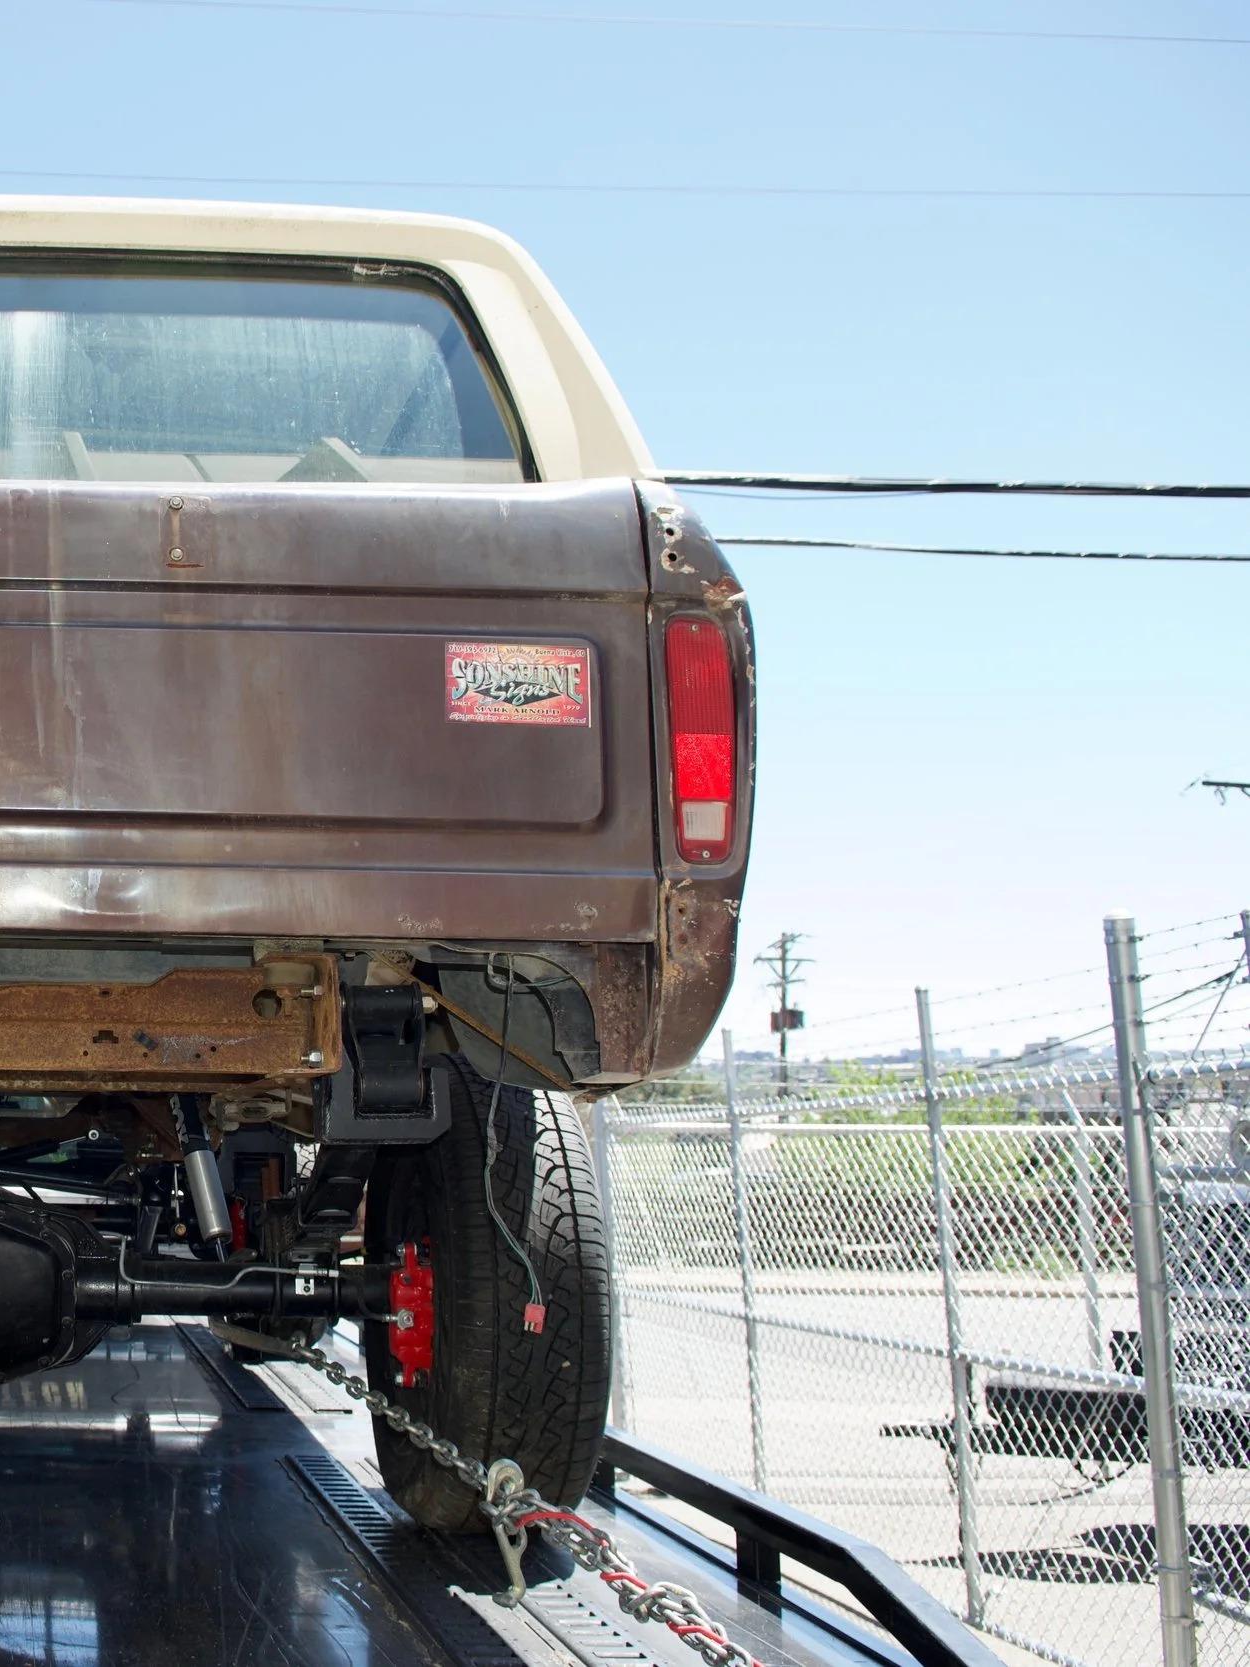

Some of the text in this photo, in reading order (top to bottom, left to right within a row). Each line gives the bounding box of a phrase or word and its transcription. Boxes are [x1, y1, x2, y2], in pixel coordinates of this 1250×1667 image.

[451, 658, 583, 704] SONSHINE
[491, 679, 551, 706] Signs
[475, 705, 561, 716] MARK ARNOLD
